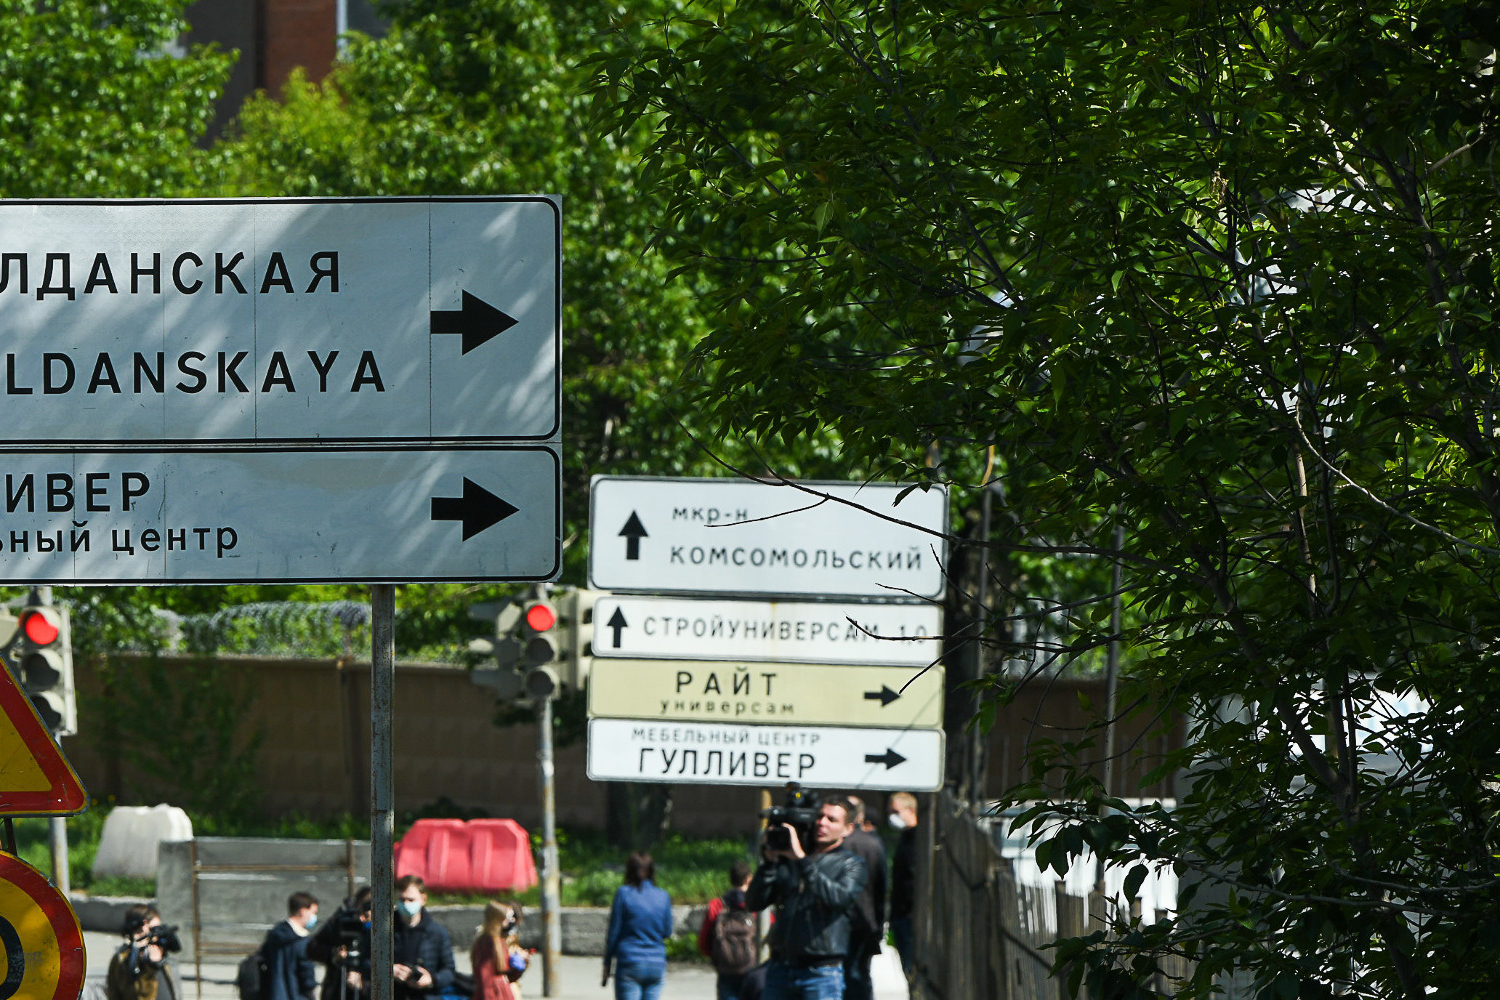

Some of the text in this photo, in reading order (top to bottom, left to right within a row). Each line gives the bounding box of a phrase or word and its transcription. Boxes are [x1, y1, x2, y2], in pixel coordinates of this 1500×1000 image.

[672, 507, 748, 524] мкр-н
[111, 525, 241, 560] центр
[670, 545, 922, 570] КОМСОМОЛЬСКИЙ
[643, 613, 879, 641] СТРОЙУНИВЕРСАМ
[675, 666, 778, 696] РАЙТ
[659, 701, 794, 716] универсам
[631, 726, 821, 746] МЕБЕЛЬНЫЙ ЦЕНТР
[638, 747, 816, 779] ГУЛЛИВЕР
